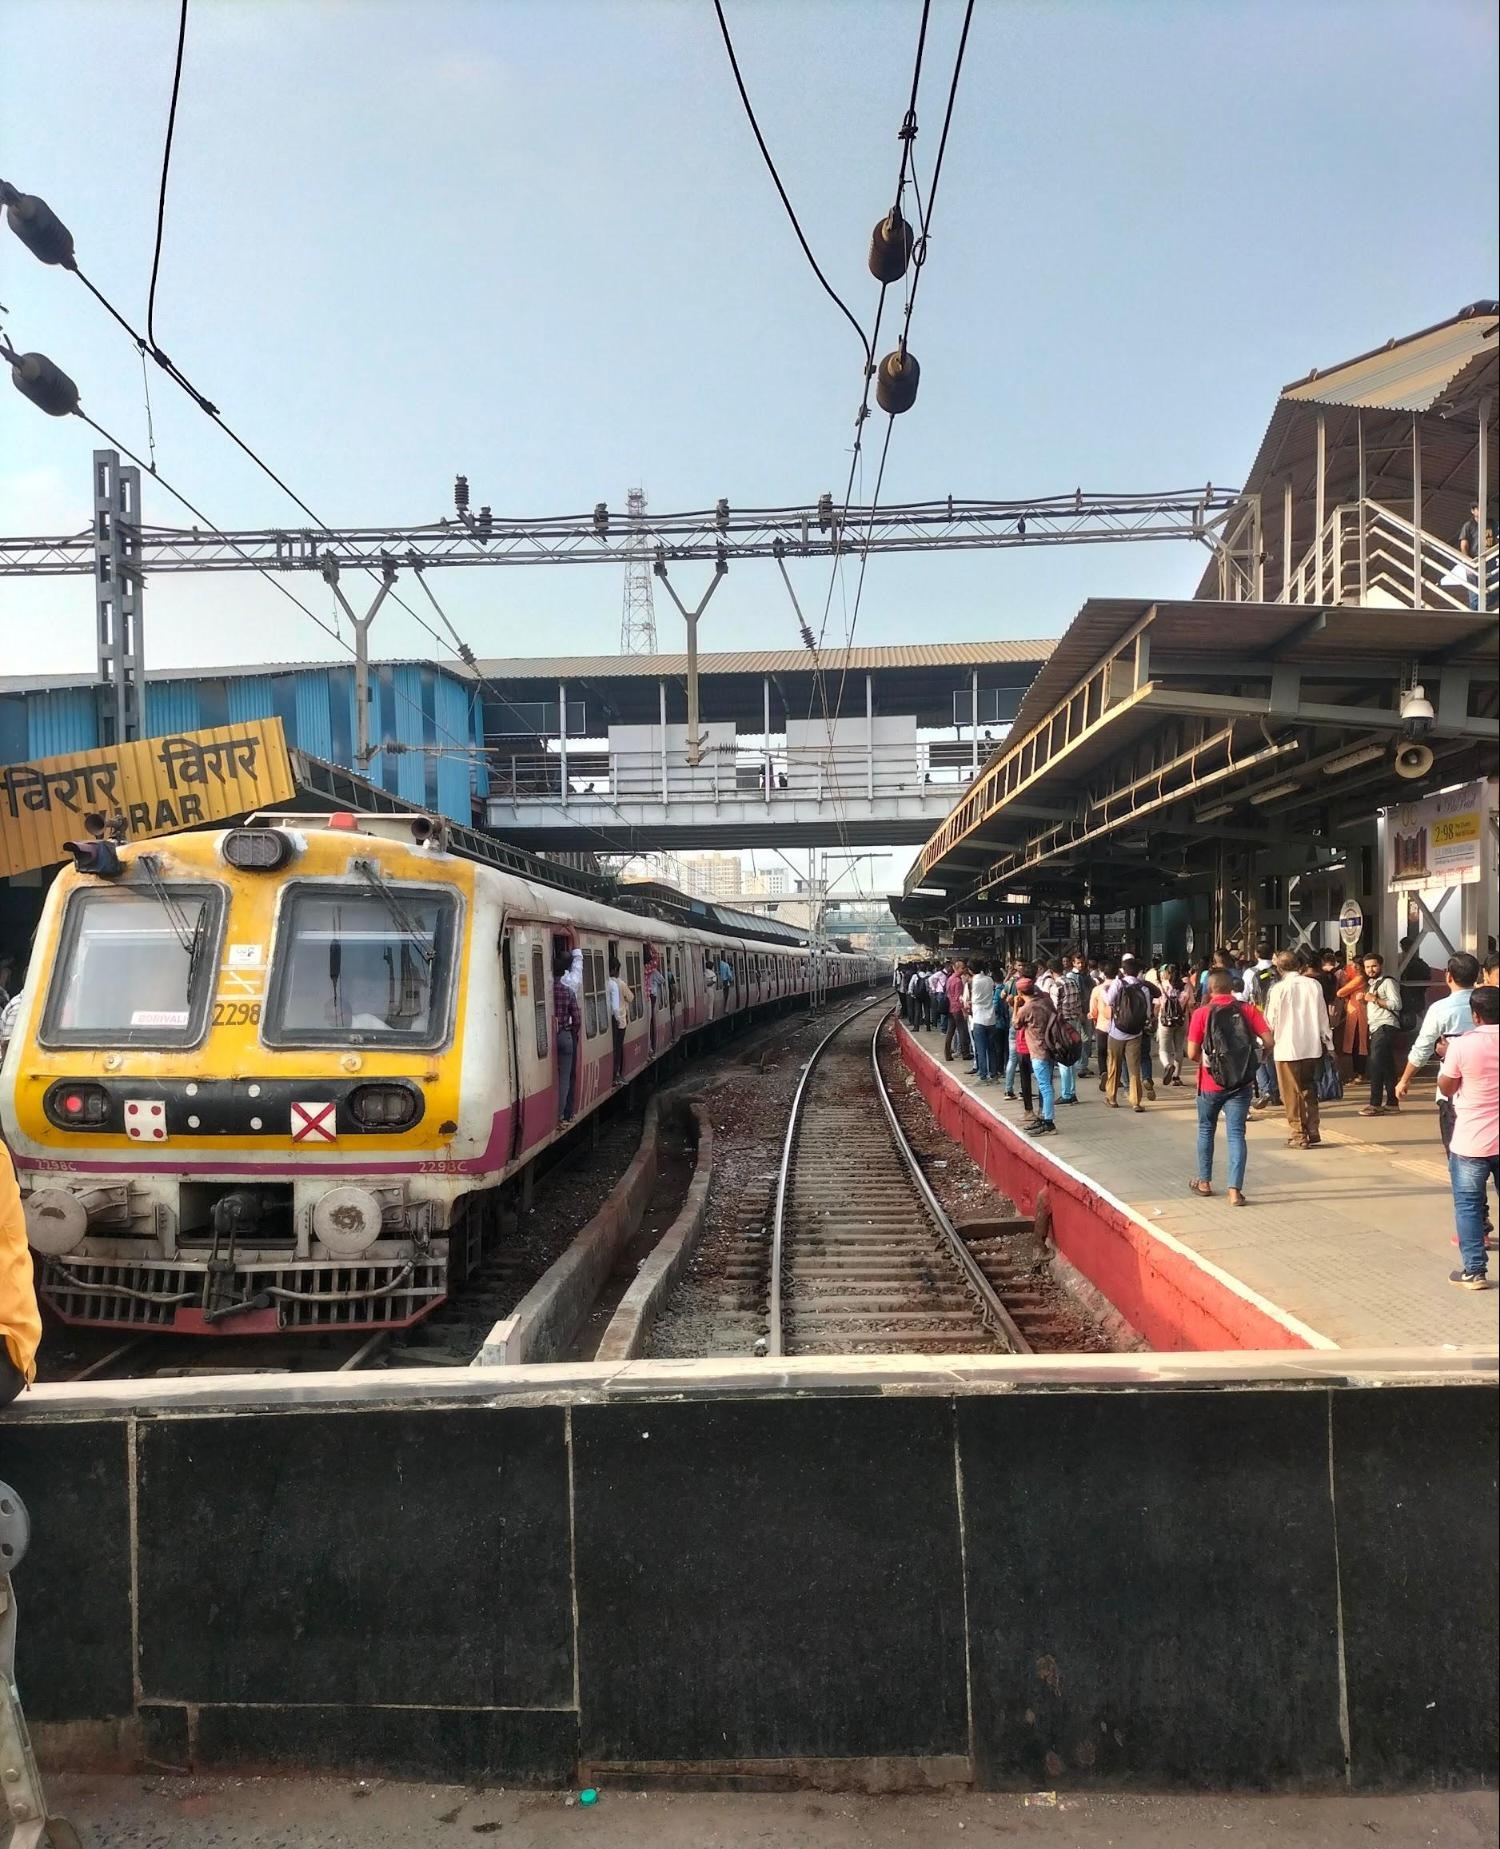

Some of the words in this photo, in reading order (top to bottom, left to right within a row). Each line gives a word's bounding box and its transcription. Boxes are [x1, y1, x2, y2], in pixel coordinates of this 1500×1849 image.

[0, 763, 118, 817] विरार
[158, 737, 259, 789] विरार
[212, 1003, 261, 1026] 2298
[36, 1160, 77, 1172] 2298C
[419, 1161, 467, 1172] 2298C
